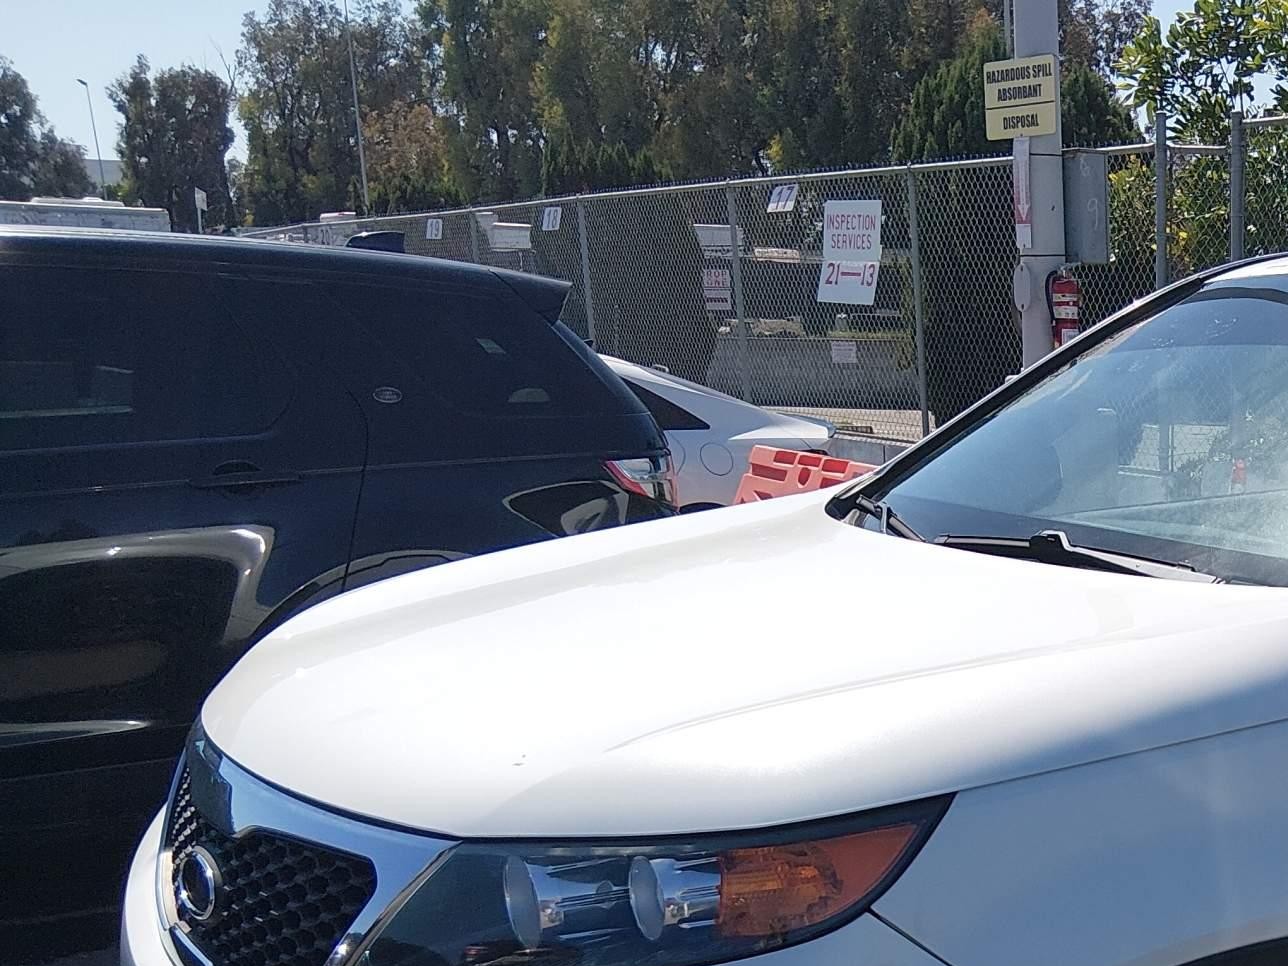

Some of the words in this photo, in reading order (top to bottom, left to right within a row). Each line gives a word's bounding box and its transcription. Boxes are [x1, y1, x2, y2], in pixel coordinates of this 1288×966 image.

[986, 65, 1031, 84] HAZARDOUS
[1032, 63, 1052, 78] SPILL
[997, 84, 1042, 102] ABSORBANT
[1003, 112, 1039, 130] DISPOSAL
[774, 185, 795, 210] 17
[546, 209, 558, 229] 18
[826, 214, 876, 231] INSPECTION
[429, 219, 439, 238] 19
[831, 234, 872, 249] SERVICES
